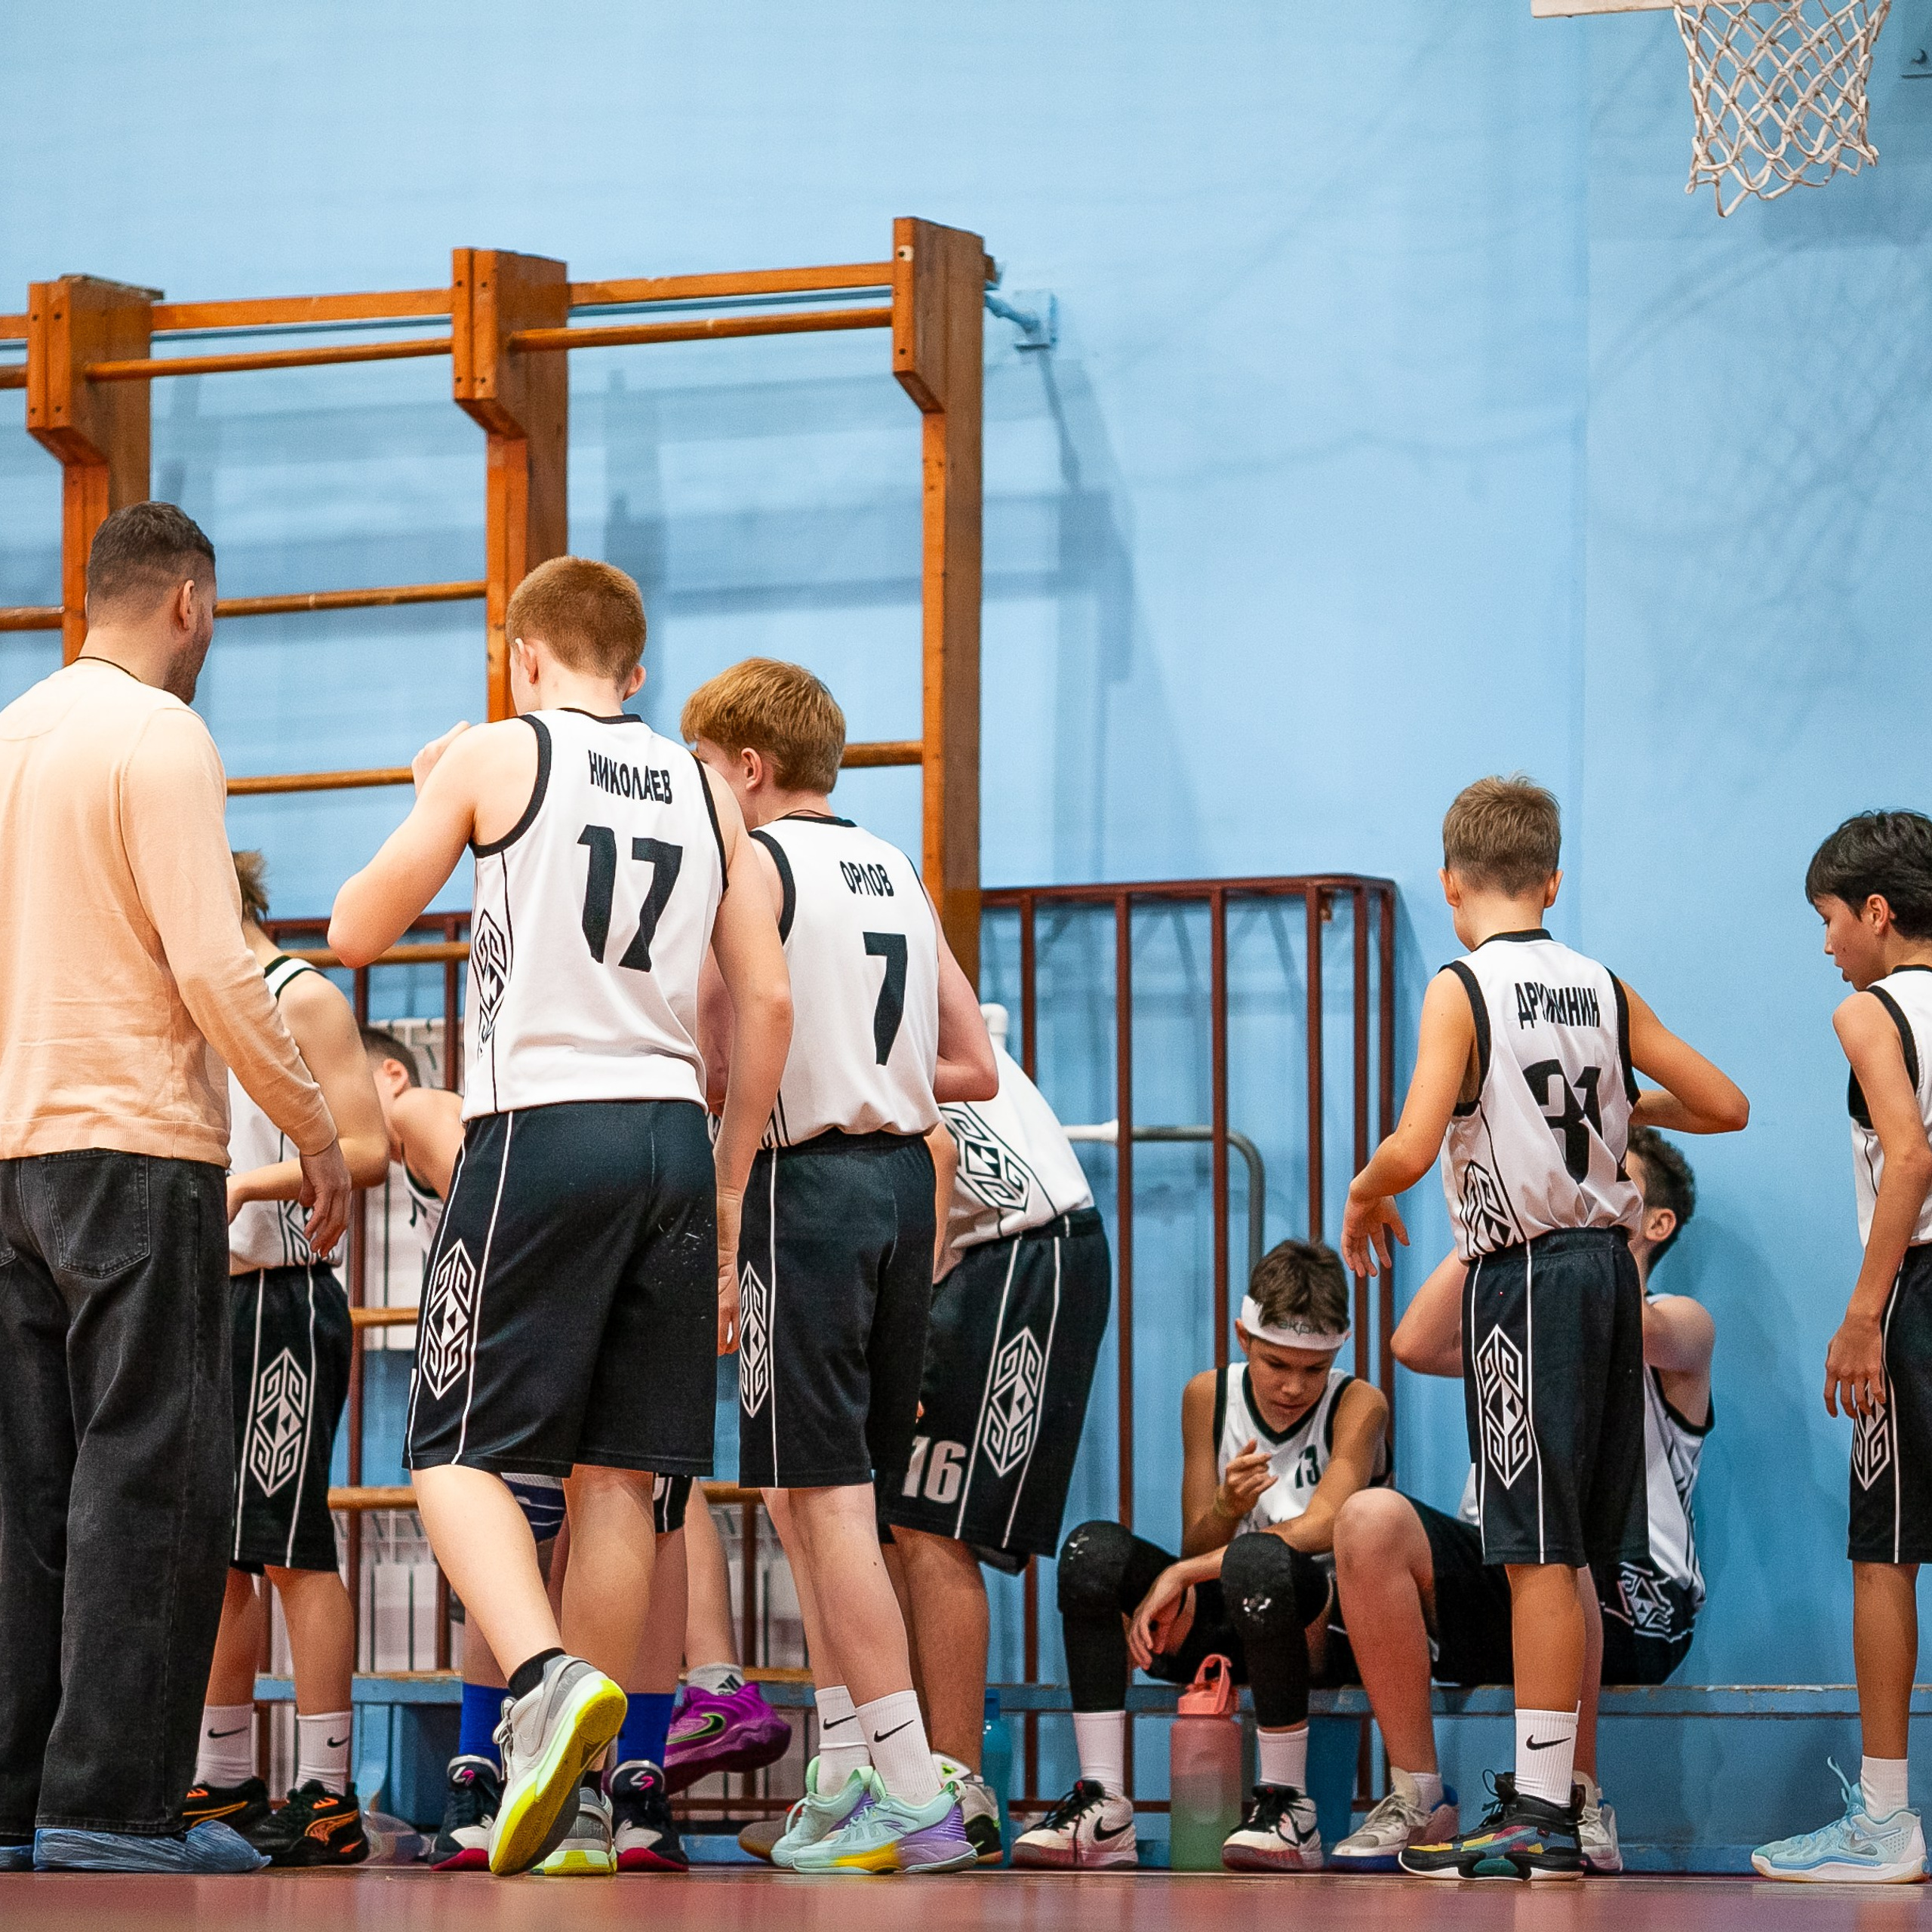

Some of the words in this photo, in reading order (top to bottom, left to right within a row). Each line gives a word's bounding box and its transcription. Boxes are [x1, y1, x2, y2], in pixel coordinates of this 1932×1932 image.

[588, 749, 672, 804] НИКОЛАЕВ
[577, 824, 683, 973] 17
[839, 860, 894, 897] ОРЛОВ
[863, 931, 908, 1066] 7
[901, 1435, 967, 1504] 16
[1294, 1444, 1321, 1489] 13
